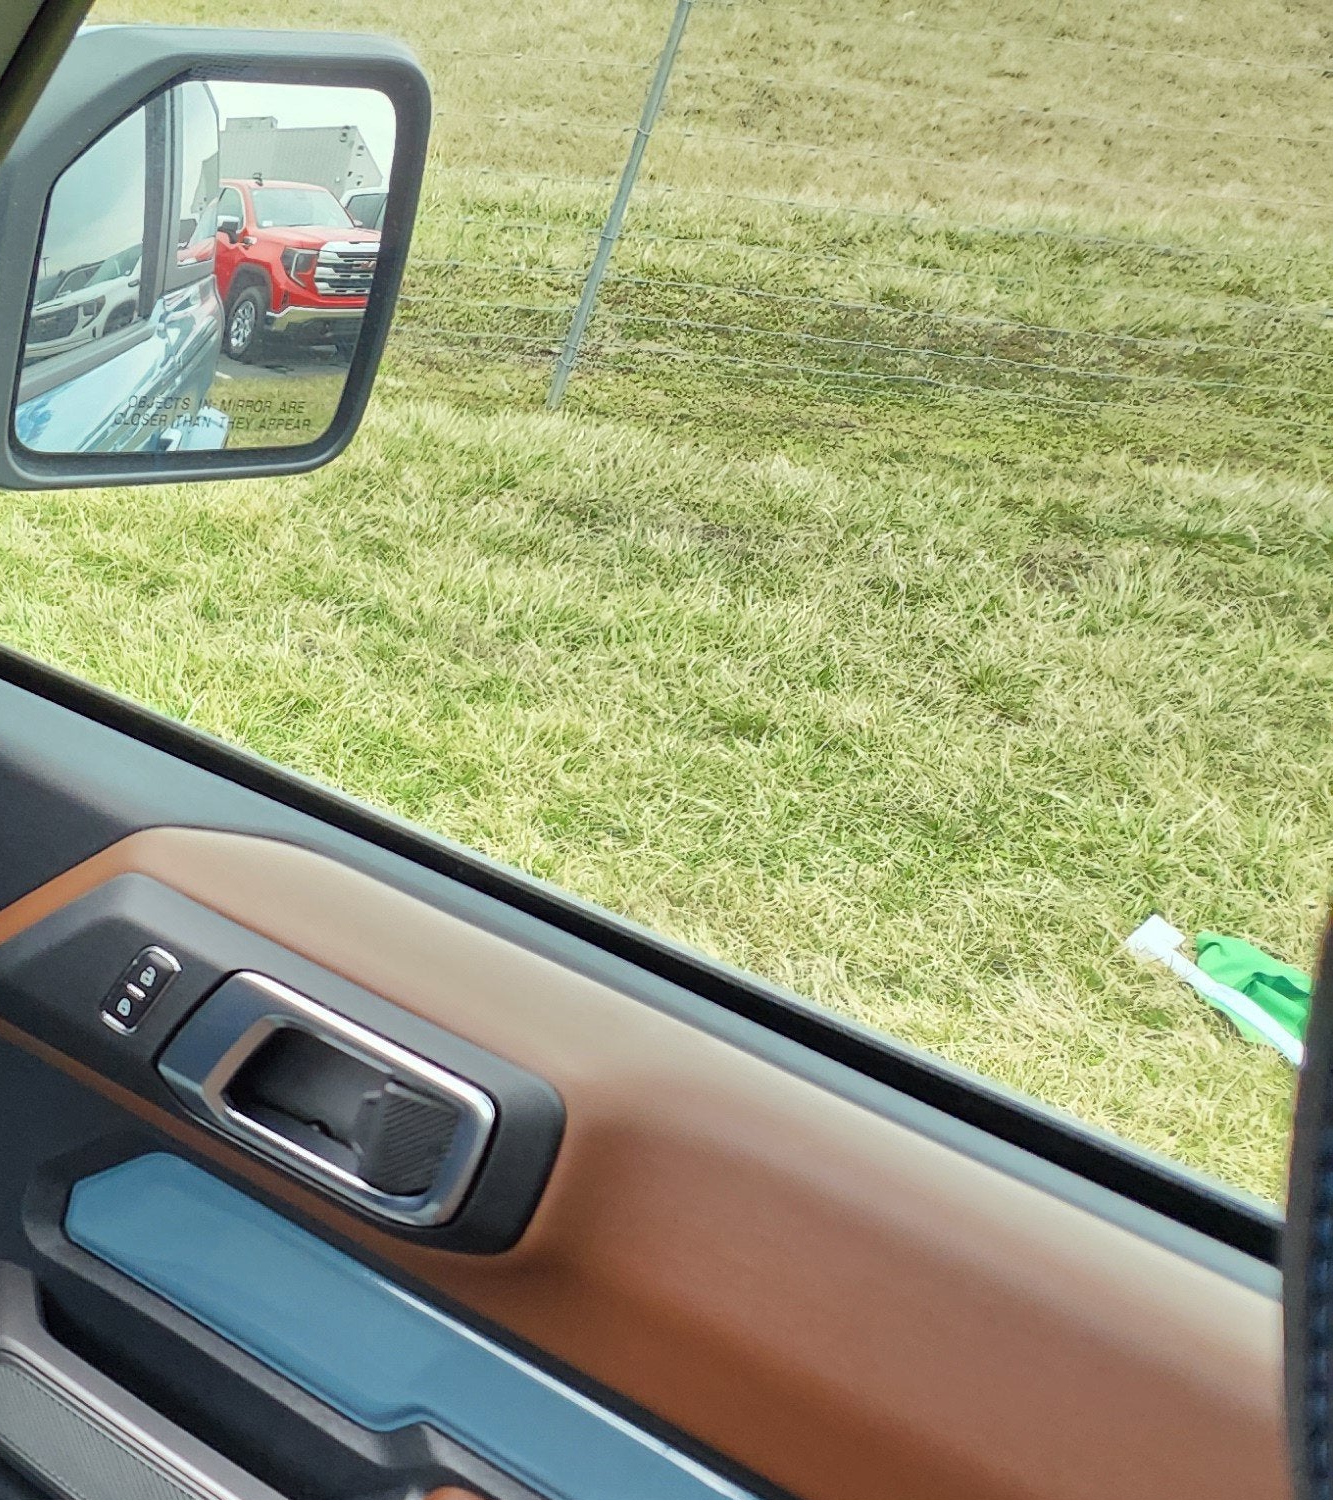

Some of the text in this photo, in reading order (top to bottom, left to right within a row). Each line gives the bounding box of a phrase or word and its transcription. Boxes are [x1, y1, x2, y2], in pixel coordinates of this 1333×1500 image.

[128, 395, 190, 410] OBJECTS
[219, 399, 271, 413] MIRROR
[279, 401, 306, 414] ARE
[114, 413, 311, 431] CLOSER THAN THEY APPEAR
